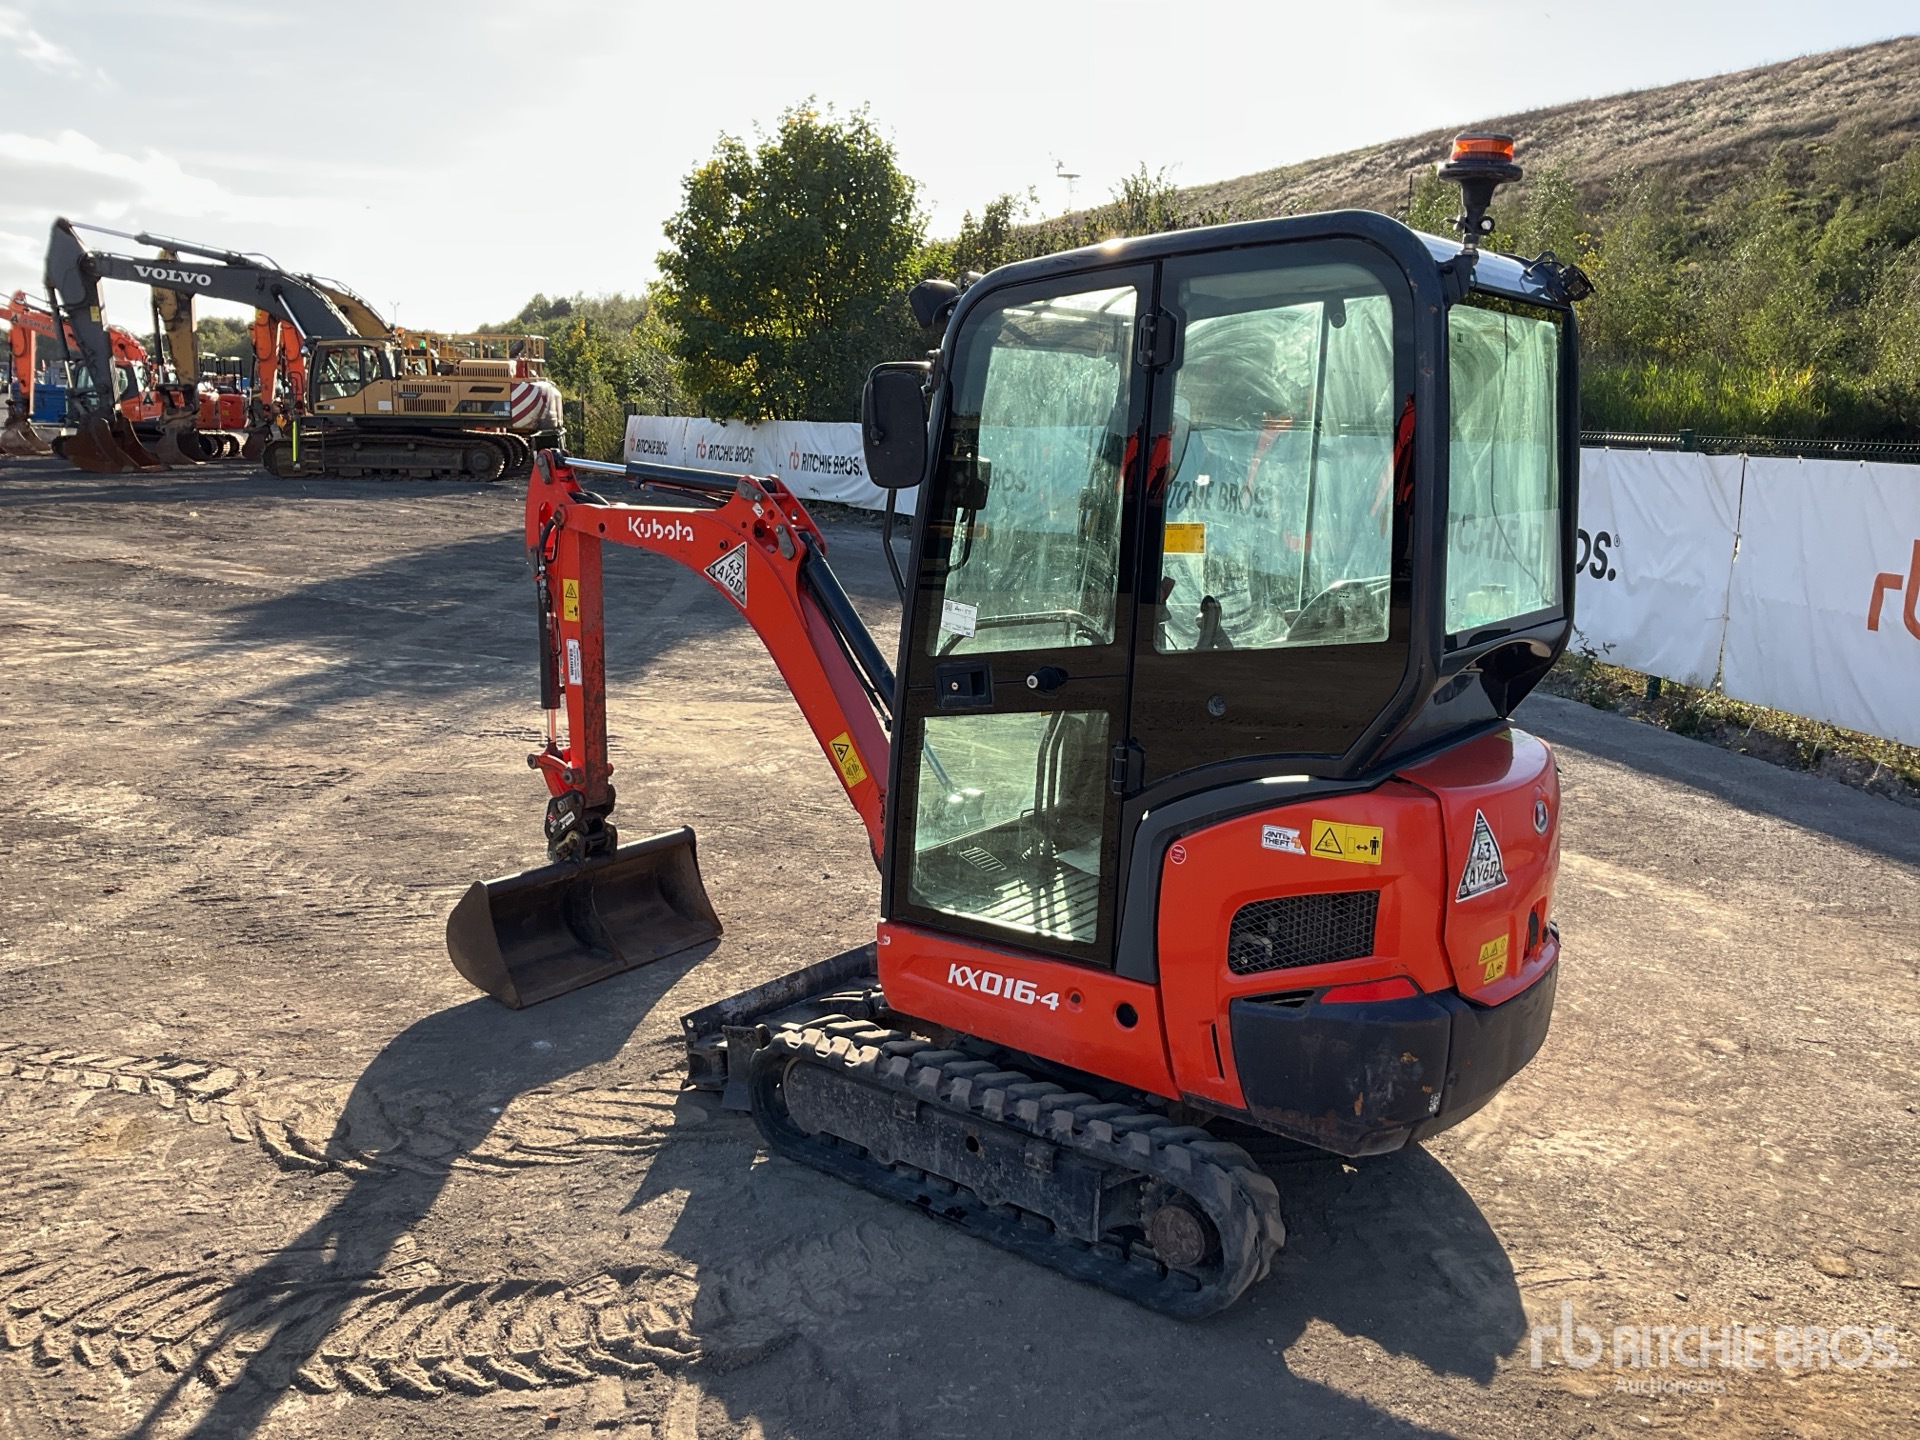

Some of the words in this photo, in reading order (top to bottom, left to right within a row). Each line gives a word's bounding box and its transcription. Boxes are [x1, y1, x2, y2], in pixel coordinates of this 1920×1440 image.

[133, 265, 212, 286] VOLVO
[708, 444, 734, 461] RITCHIE
[801, 453, 832, 474] RITCHIE
[833, 455, 862, 476] BROS.
[628, 516, 694, 542] Kubota
[716, 565, 743, 592] AY6D
[728, 559, 742, 576] 43
[1264, 836, 1290, 847] THEFT
[1476, 841, 1491, 862] 43
[1468, 860, 1498, 886] AY6D
[947, 963, 1060, 1011] KX016-4
